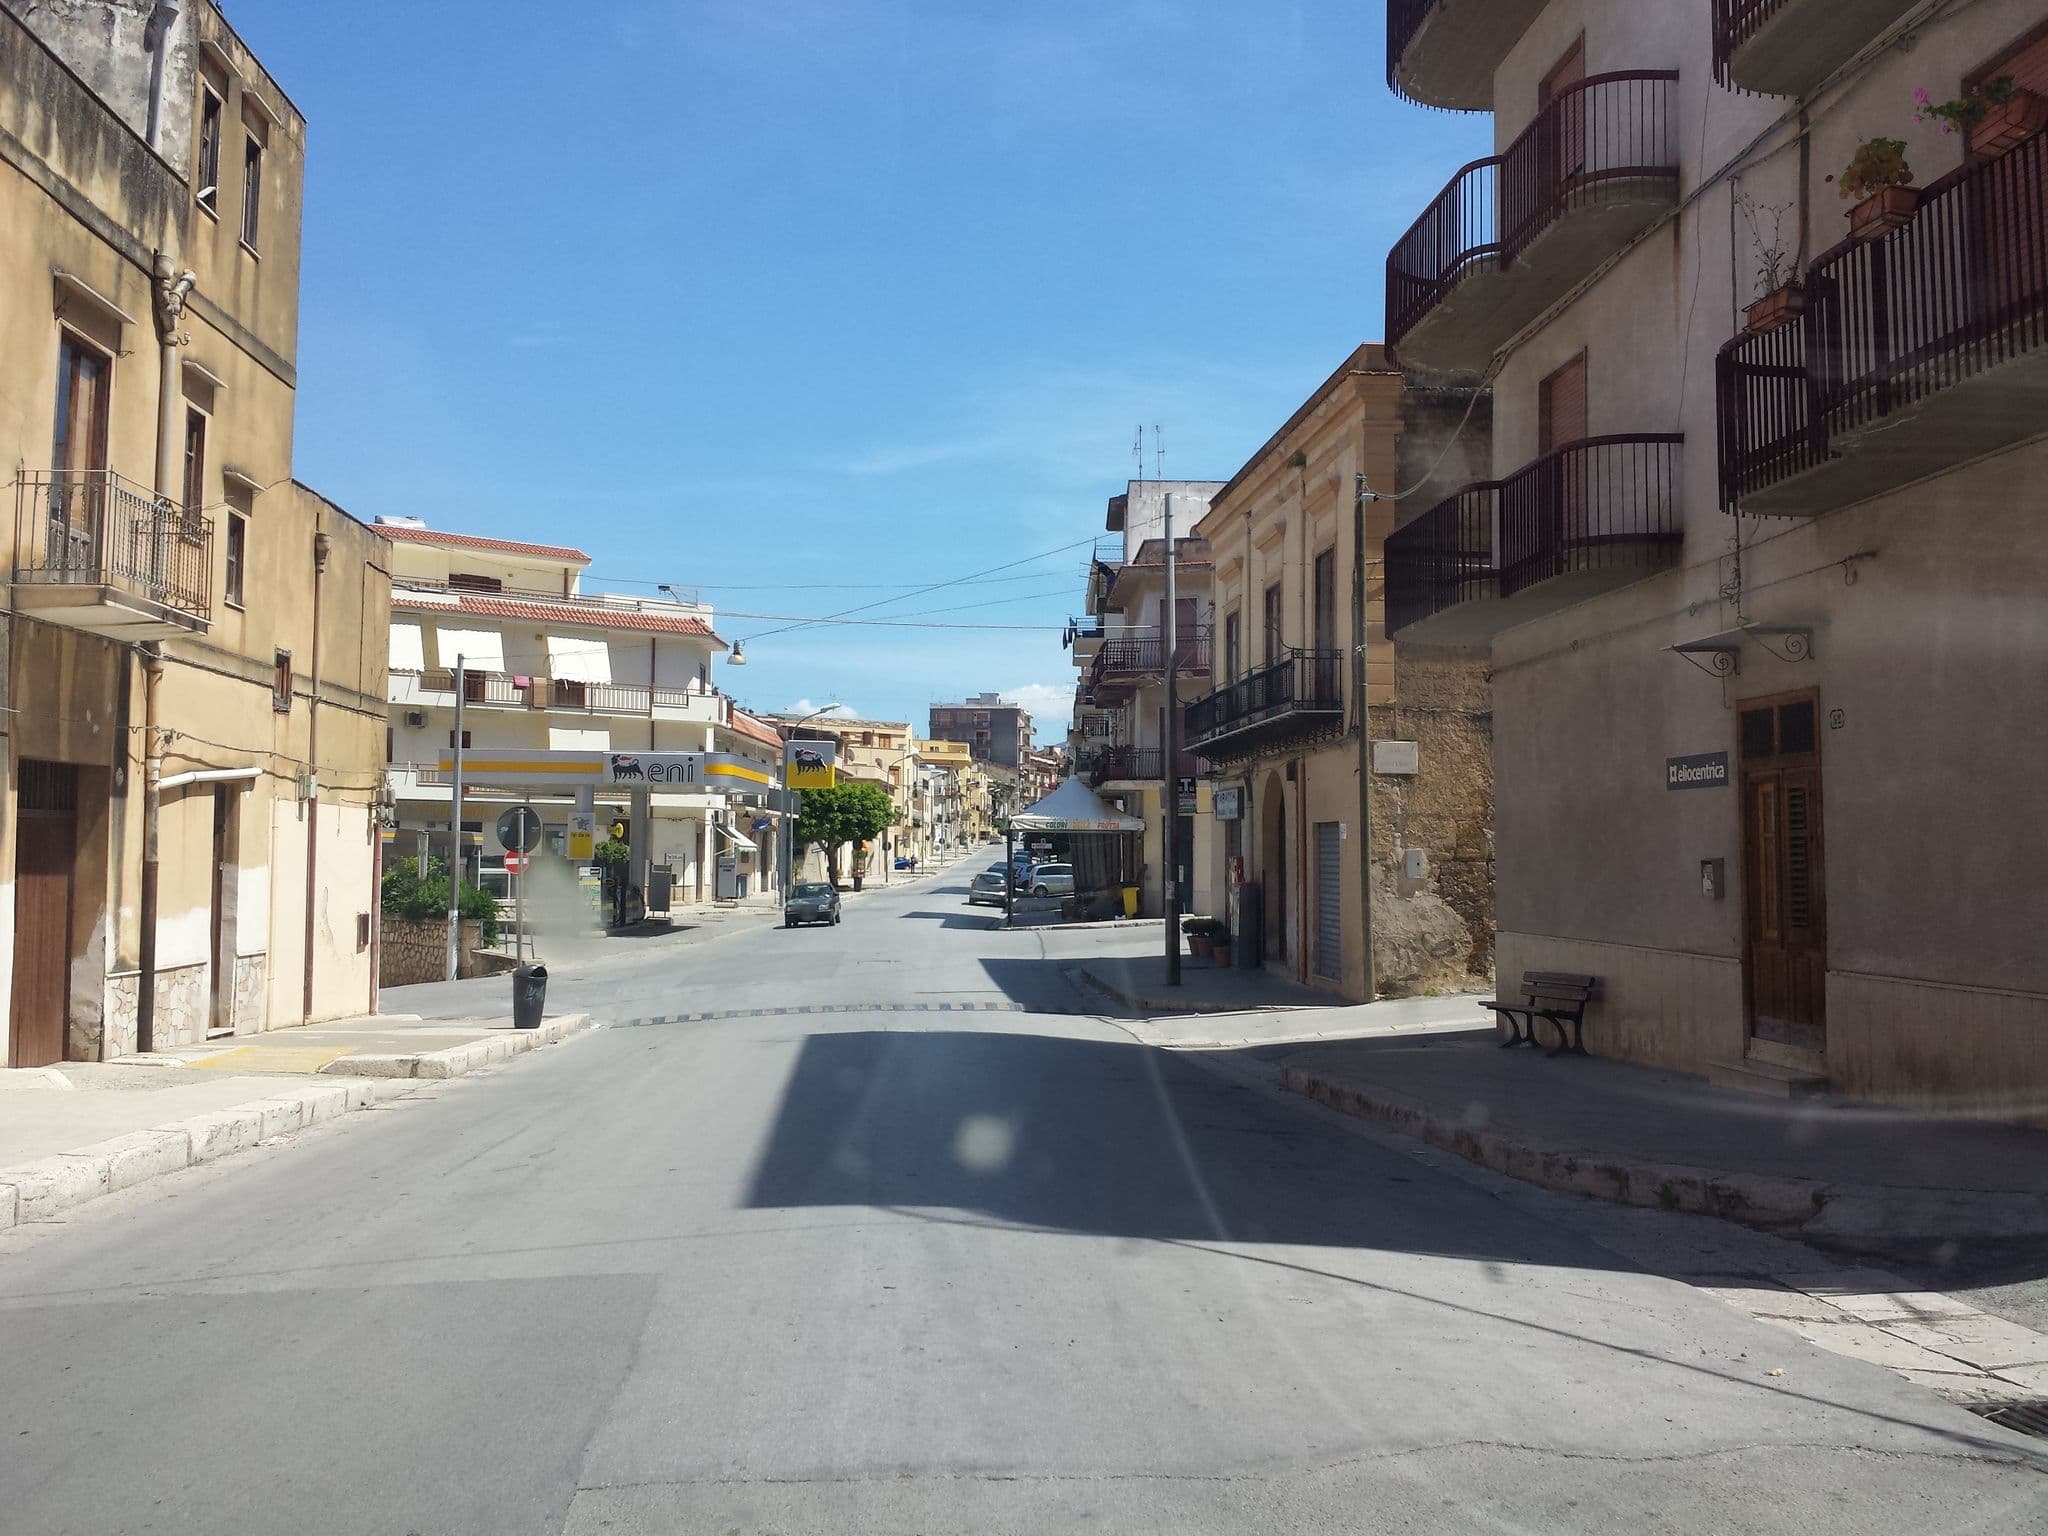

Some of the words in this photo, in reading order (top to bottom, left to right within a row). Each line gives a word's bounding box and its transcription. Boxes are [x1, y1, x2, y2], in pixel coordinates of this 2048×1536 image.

[647, 756, 694, 783] eni
[1678, 761, 1725, 782] eliocentrica
[1045, 821, 1068, 829] COLORI
